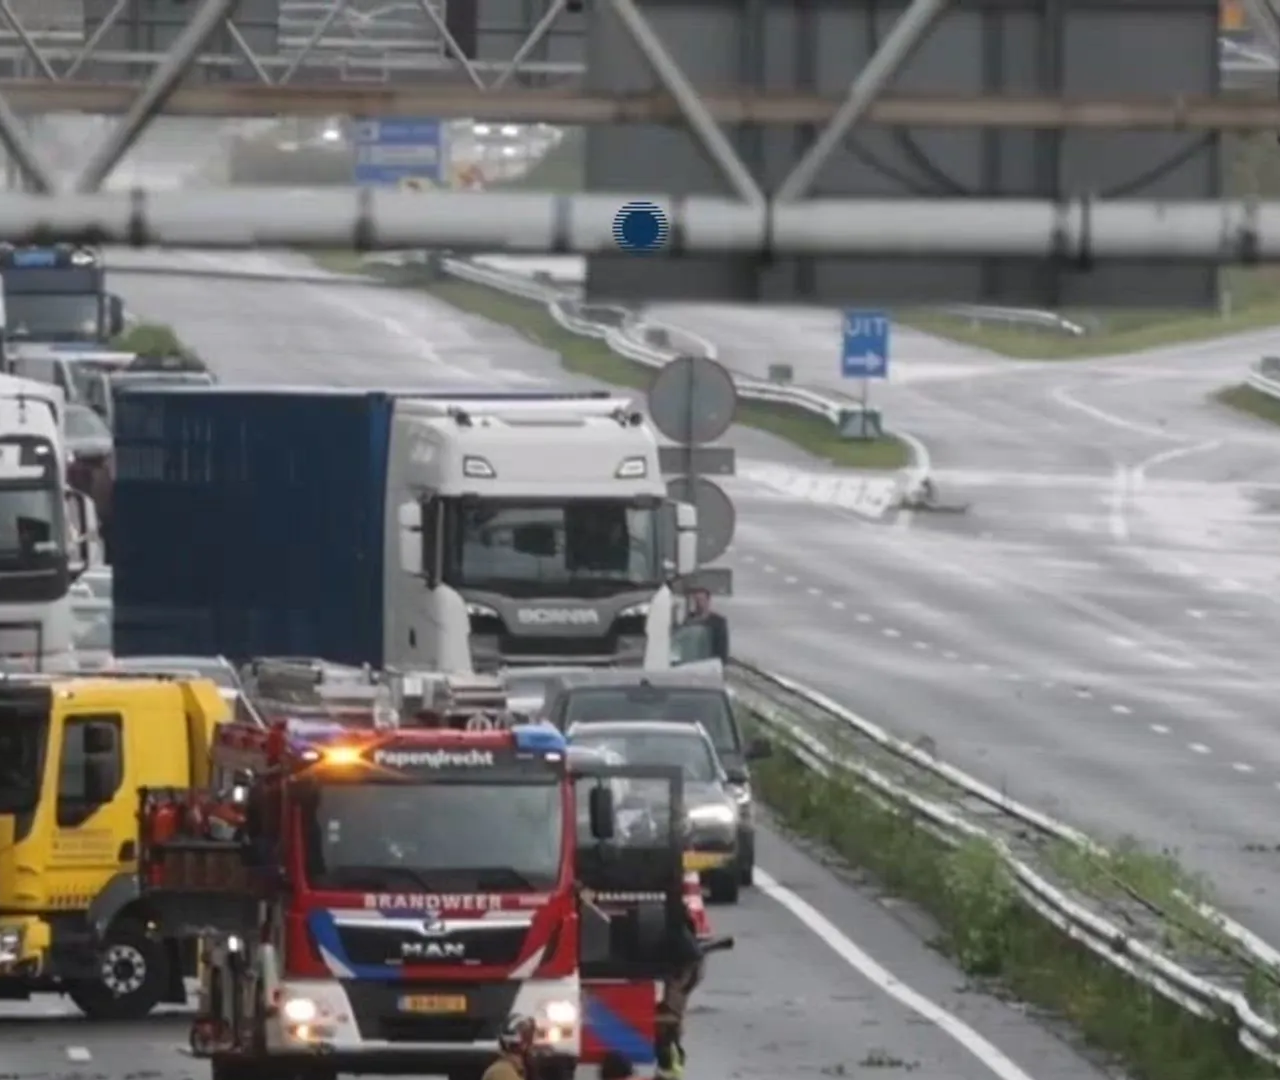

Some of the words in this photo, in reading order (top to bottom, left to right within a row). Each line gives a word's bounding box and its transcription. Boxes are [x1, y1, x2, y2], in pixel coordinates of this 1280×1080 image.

[846, 317, 888, 337] UIT
[517, 607, 598, 625] SCANIA
[373, 748, 494, 768] Papendrecht
[364, 893, 502, 909] BRANDWEER
[598, 891, 667, 901] BRANDWEER
[401, 942, 465, 957] MAN
